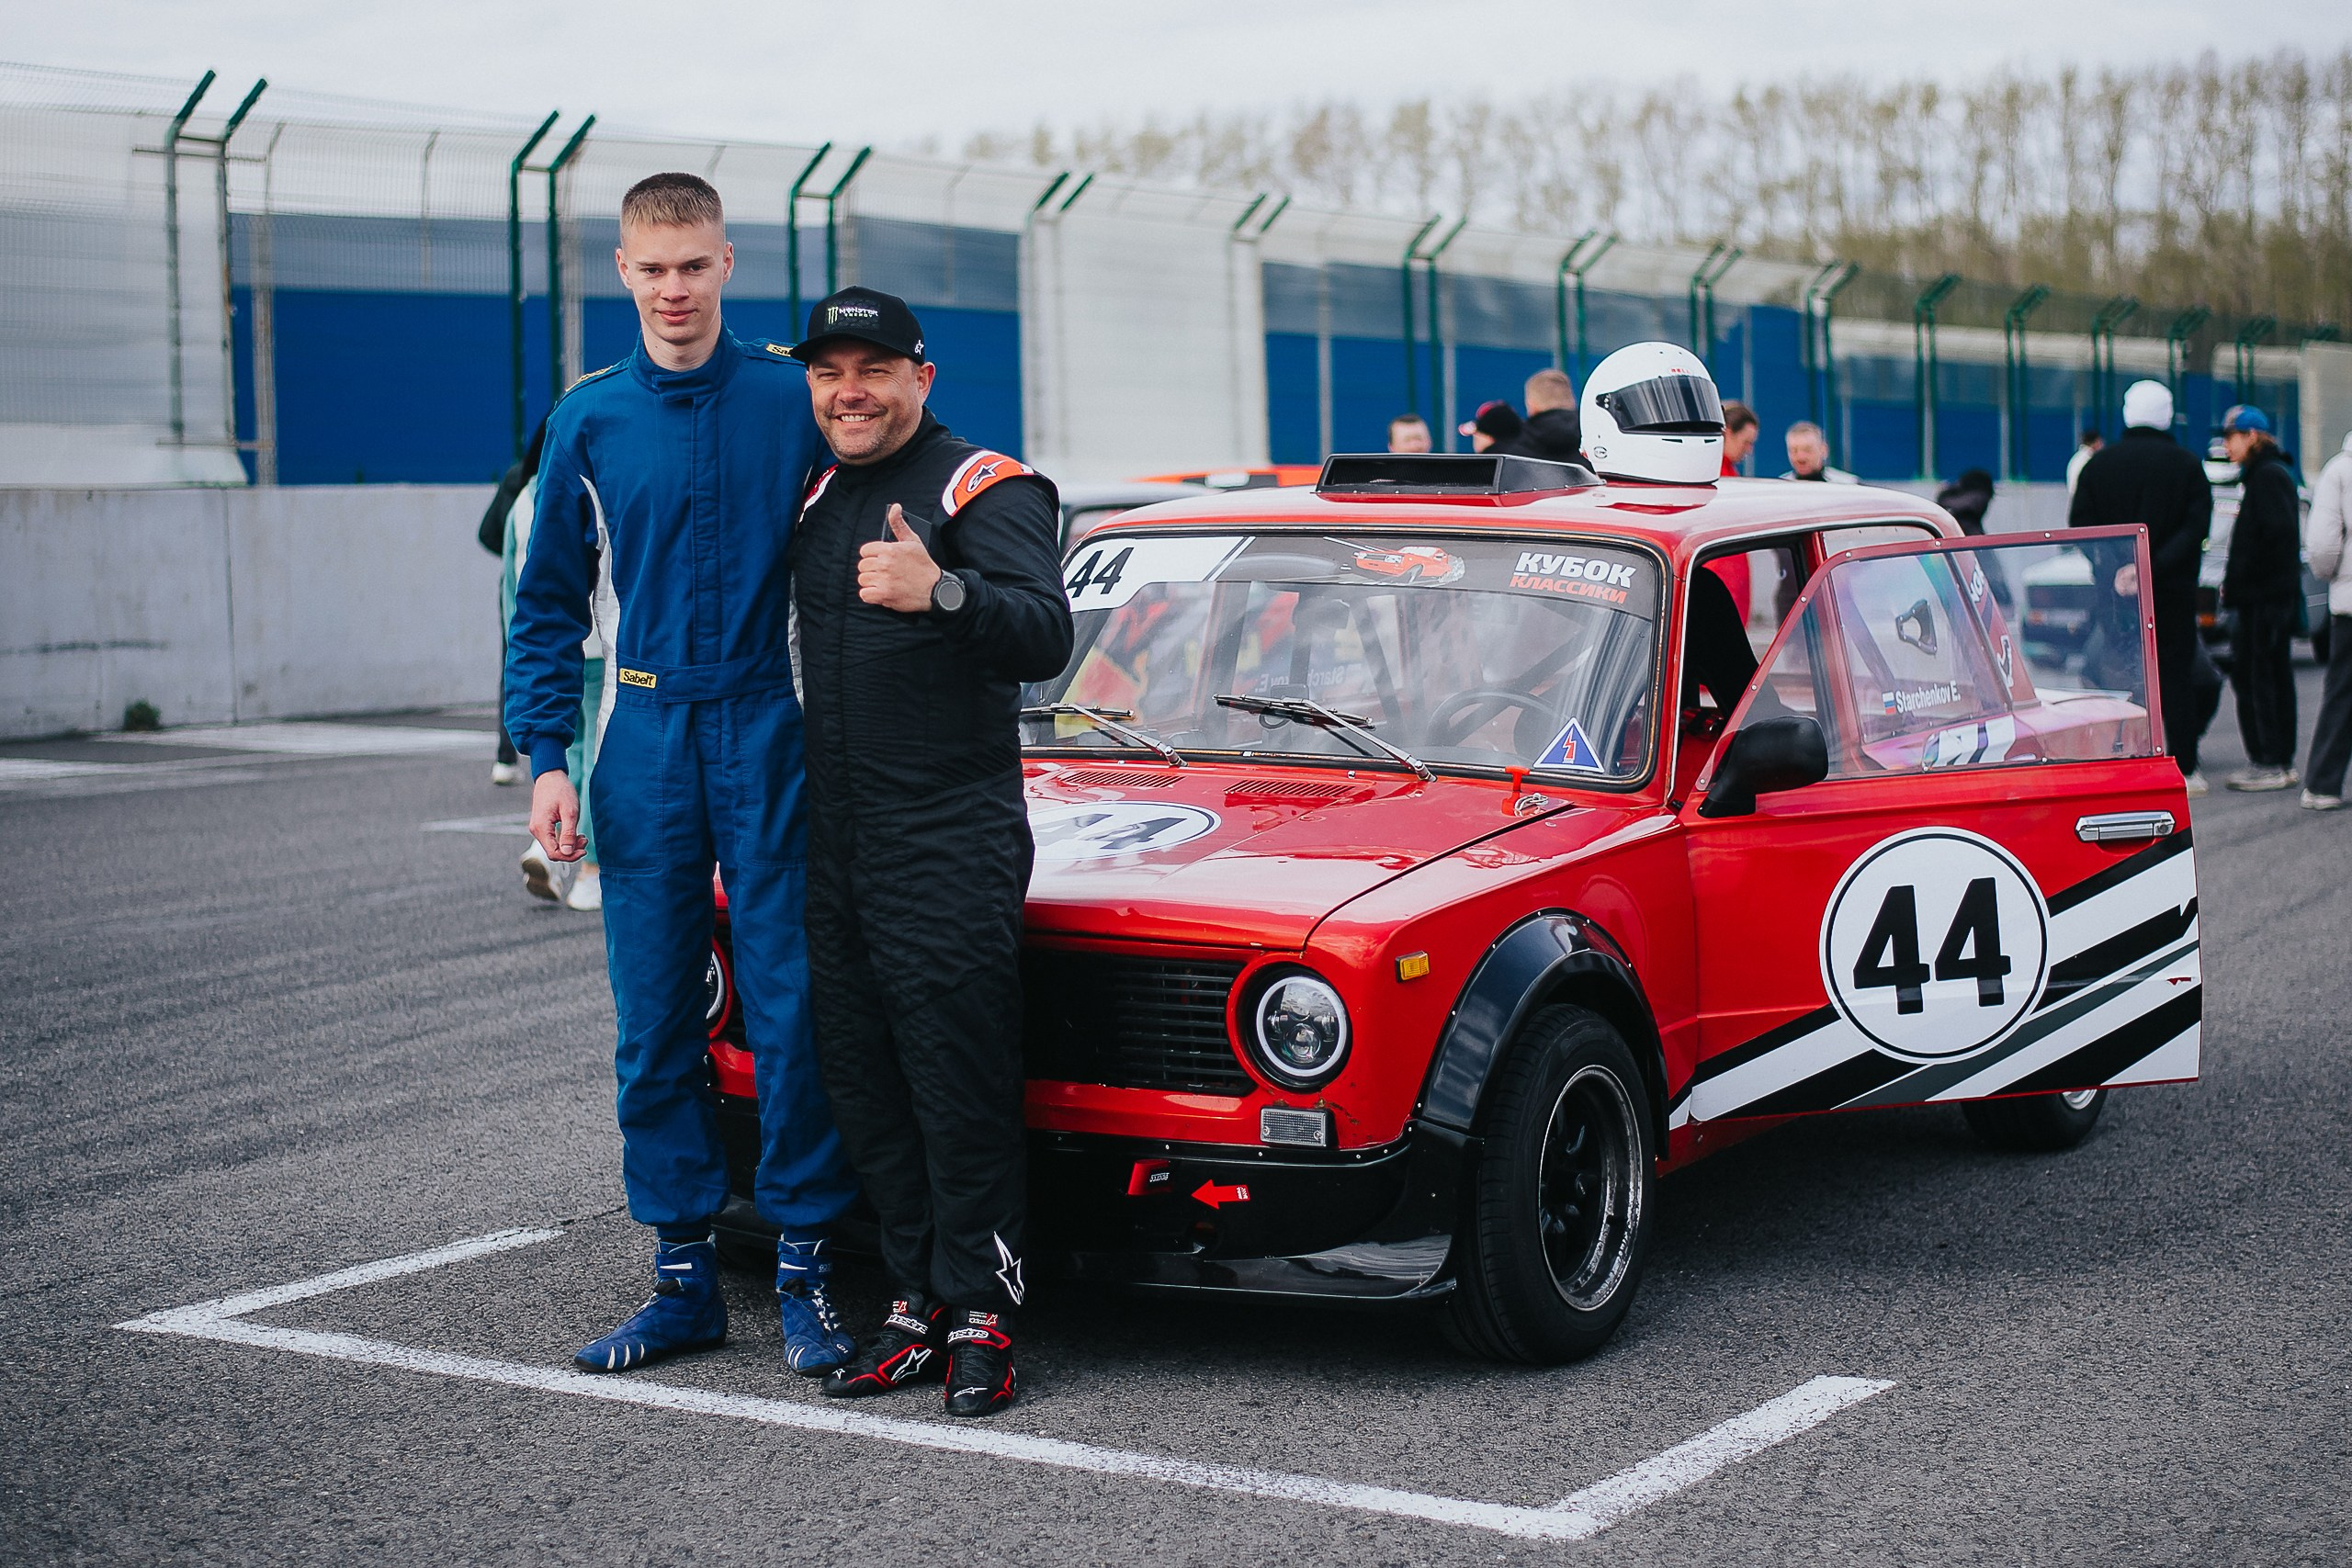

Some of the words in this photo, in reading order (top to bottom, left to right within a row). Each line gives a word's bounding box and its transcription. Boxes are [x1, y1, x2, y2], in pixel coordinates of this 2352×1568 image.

[838, 307, 878, 317] MONSTER
[1065, 547, 1135, 599] 44
[1513, 551, 1636, 589] КУБОК
[1509, 575, 1628, 604] КЛАССИКИ
[1895, 682, 1951, 714] Starchenkov
[1950, 680, 1962, 702] E.
[1035, 813, 1188, 850] 44
[1852, 876, 2012, 1015] 44
